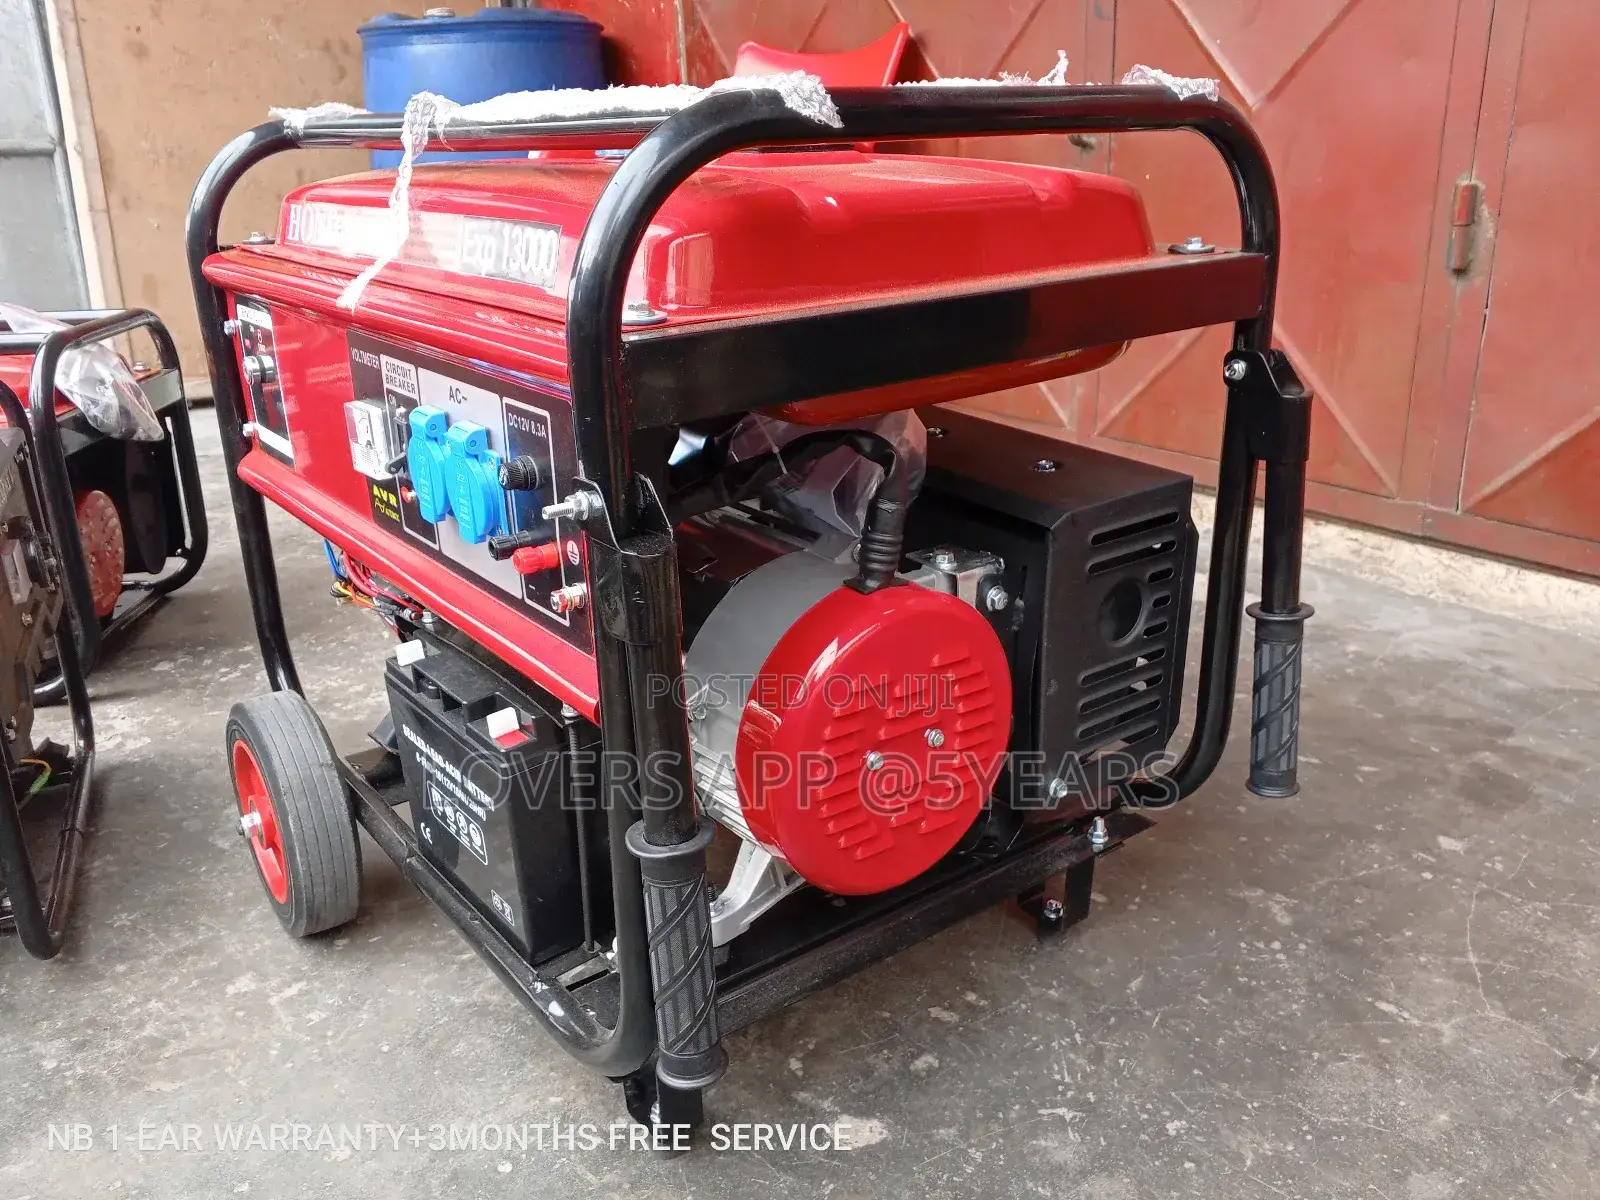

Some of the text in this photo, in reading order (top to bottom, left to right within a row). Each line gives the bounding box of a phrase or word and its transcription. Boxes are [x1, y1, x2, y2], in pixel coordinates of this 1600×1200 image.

[501, 223, 558, 278] 13000
[351, 347, 380, 370] VOLTMETER
[385, 360, 412, 381] CIRCUIT
[385, 373, 416, 395] BREAKER
[508, 412, 530, 433] DC12V
[373, 484, 398, 508] AVR
